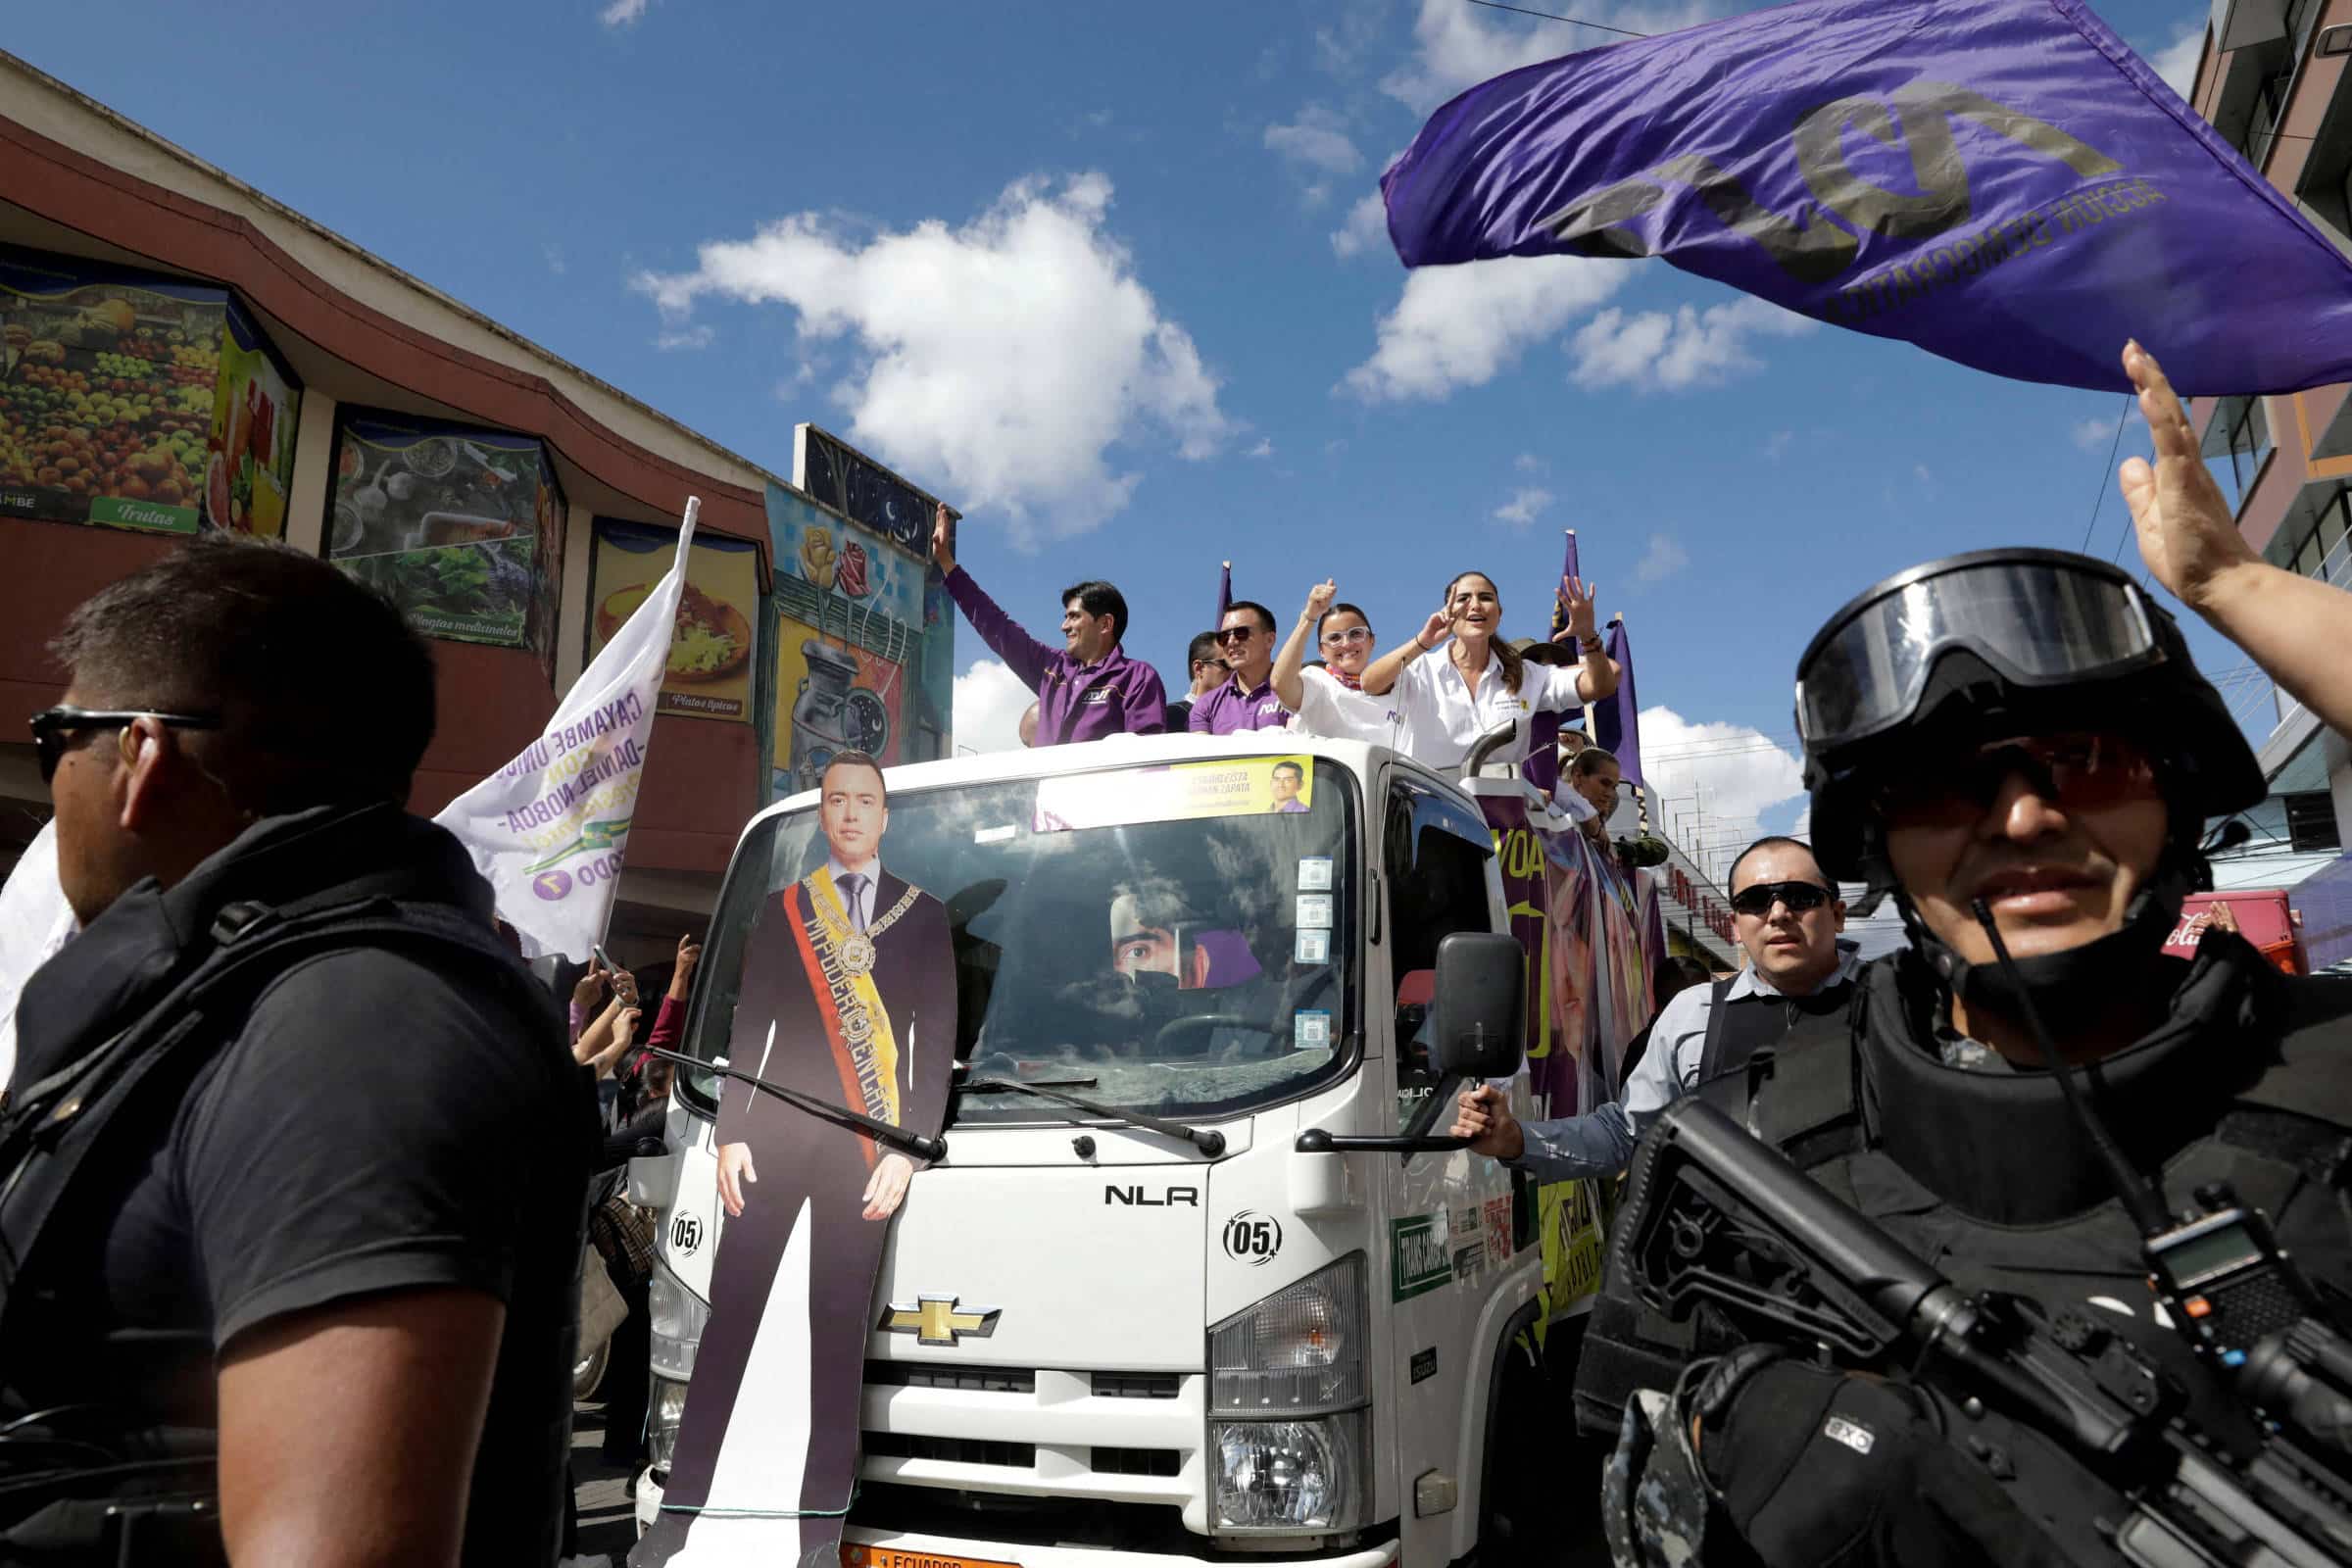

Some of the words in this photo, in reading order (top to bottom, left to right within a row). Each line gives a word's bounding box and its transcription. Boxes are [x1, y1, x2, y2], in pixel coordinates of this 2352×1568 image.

[0, 494, 36, 509] MBE
[118, 503, 174, 526] Frutas
[454, 619, 517, 637] medicinales
[671, 694, 707, 709] Platos
[1105, 1186, 1199, 1206] NLR
[675, 1219, 697, 1249] 05
[1234, 1221, 1270, 1254] 05
